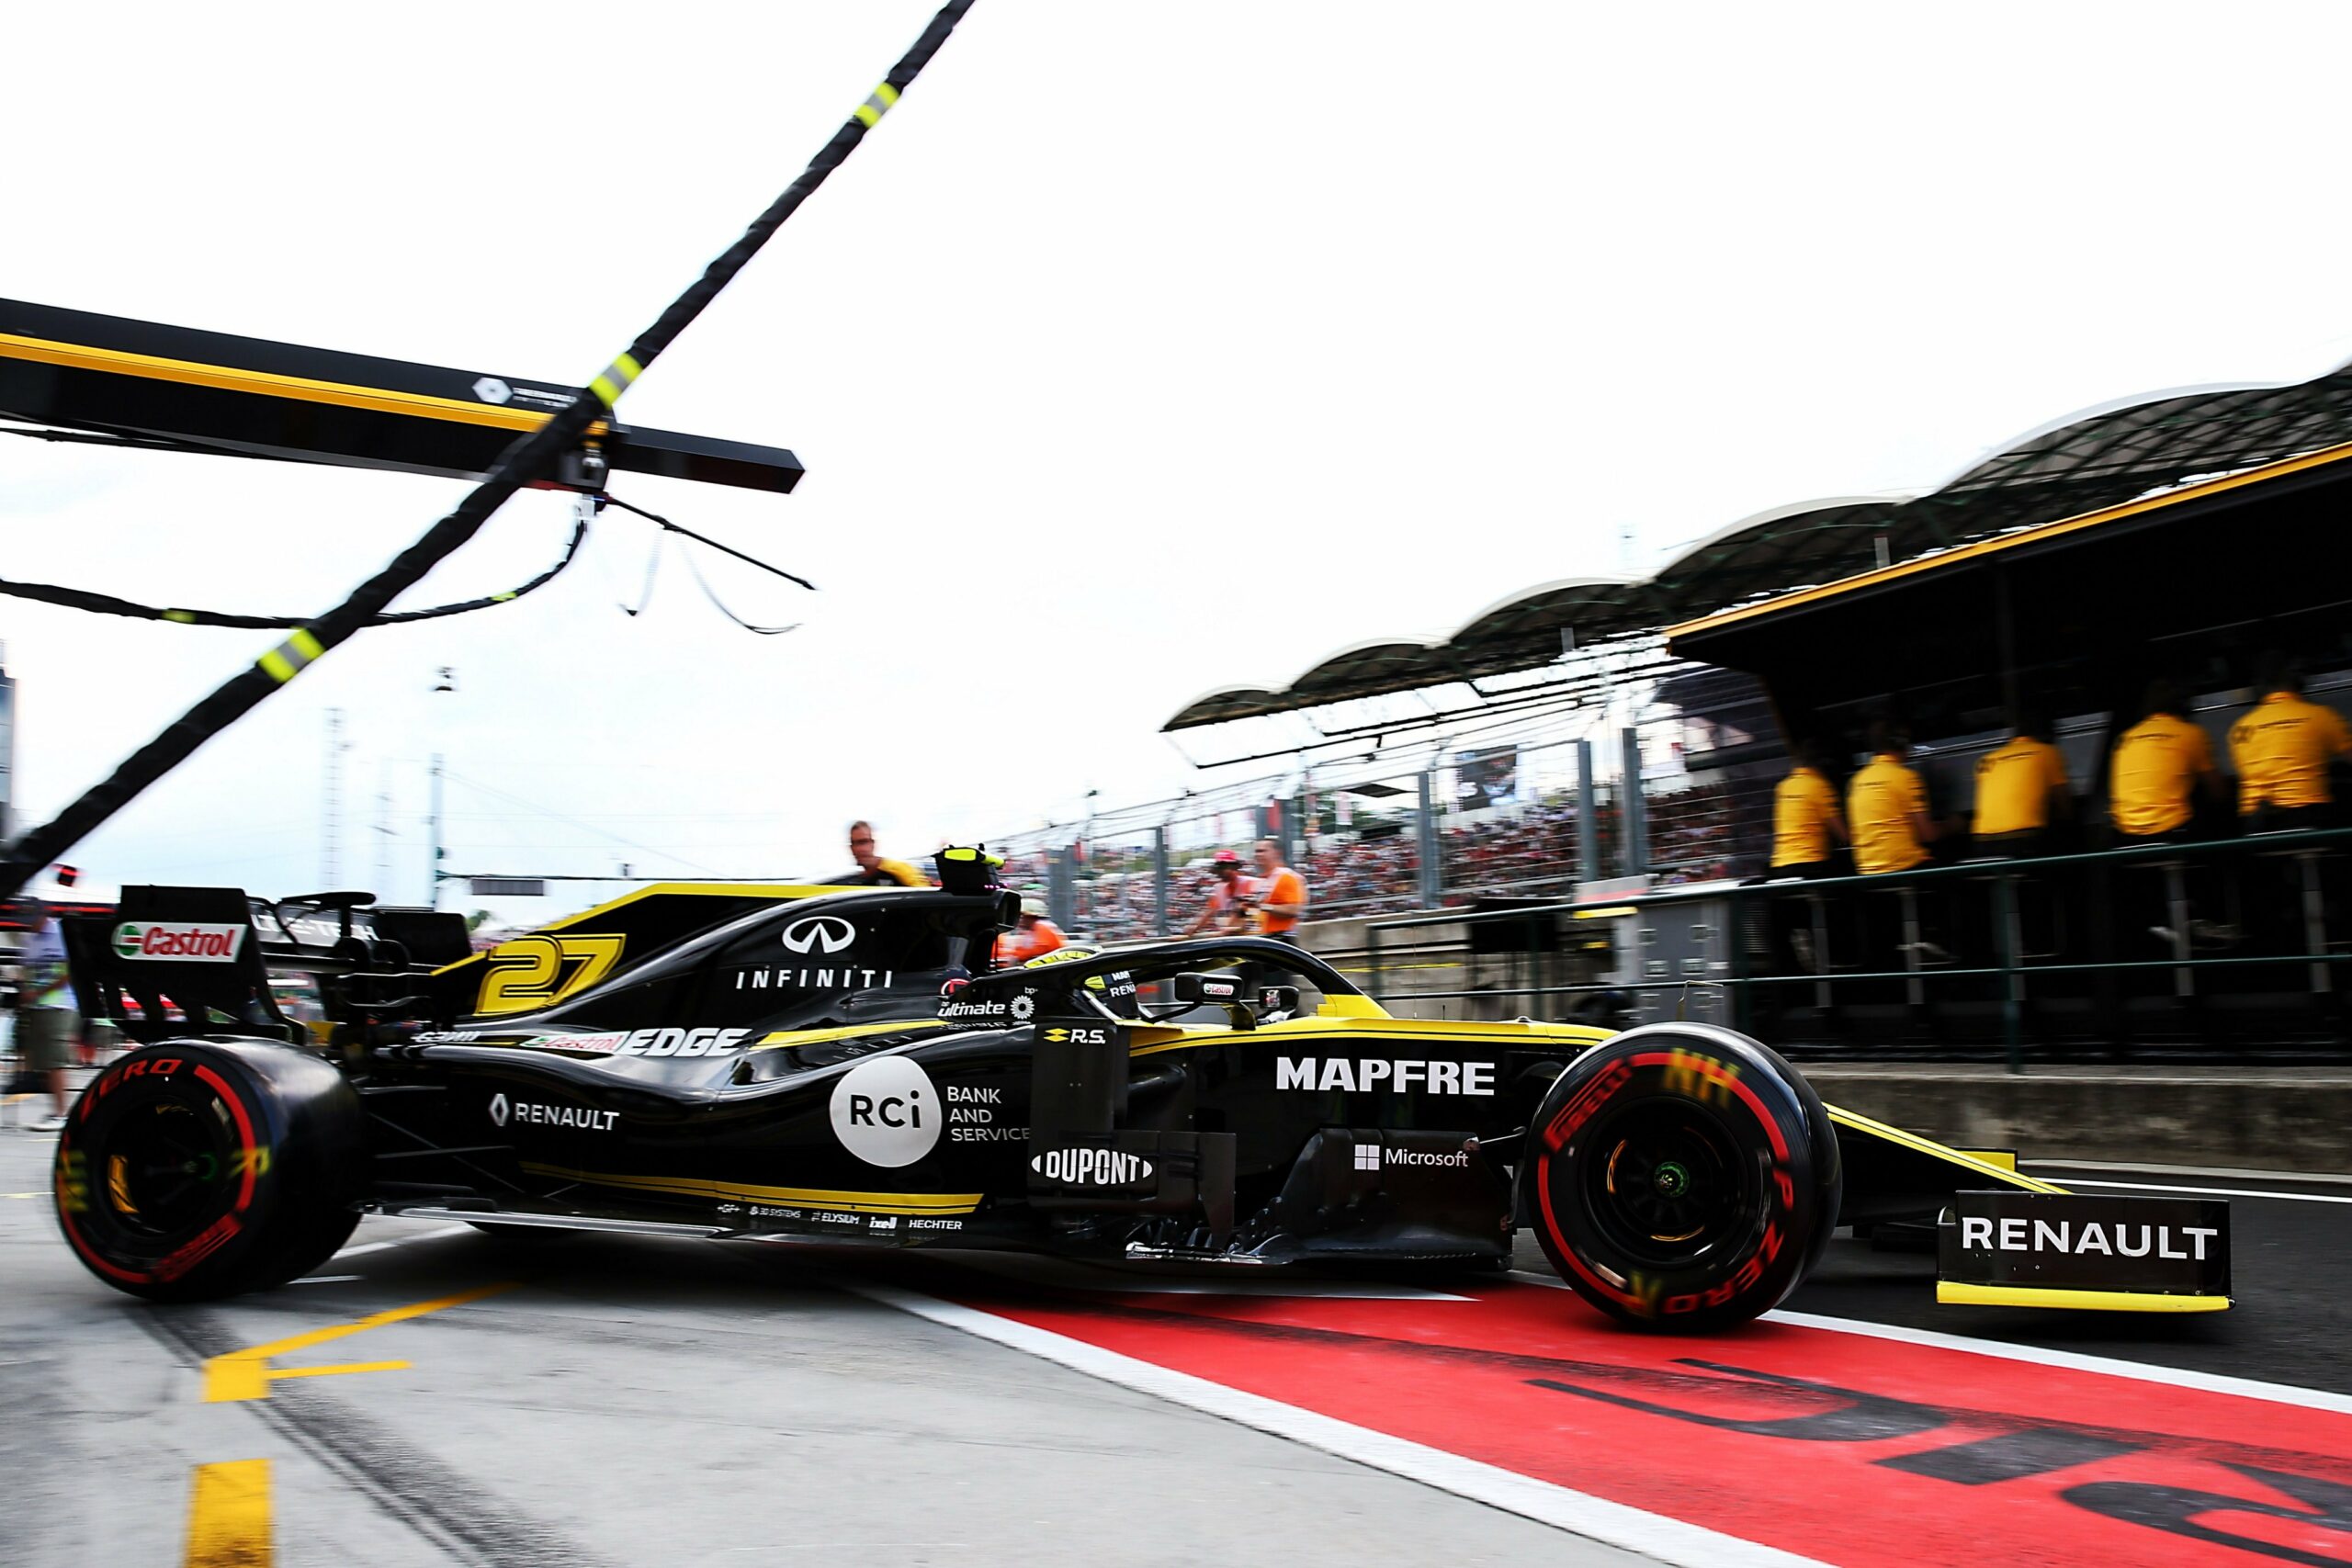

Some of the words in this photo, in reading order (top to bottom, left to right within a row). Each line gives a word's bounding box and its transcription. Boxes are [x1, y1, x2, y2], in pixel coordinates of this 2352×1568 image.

[142, 926, 235, 957] Castrol
[472, 933, 627, 1017] 27
[736, 969, 892, 989] INFINITI
[937, 1000, 1005, 1017] ultimate
[545, 1035, 622, 1052] Castrol
[616, 1027, 752, 1057] EDGE
[1070, 1029, 1106, 1044] R.S.
[1276, 1056, 1495, 1096] MAPFRE
[947, 1086, 1001, 1104] BANK
[514, 1102, 619, 1131] RENAULT
[949, 1108, 992, 1122] AND
[1046, 1148, 1139, 1185] DUPONT
[1385, 1148, 1468, 1168] Microsoft
[821, 1212, 860, 1224] ELYSIUM
[909, 1219, 963, 1230] HECHTER
[1962, 1216, 2218, 1260] RENAULT
[1662, 1221, 1784, 1314] ZERO
